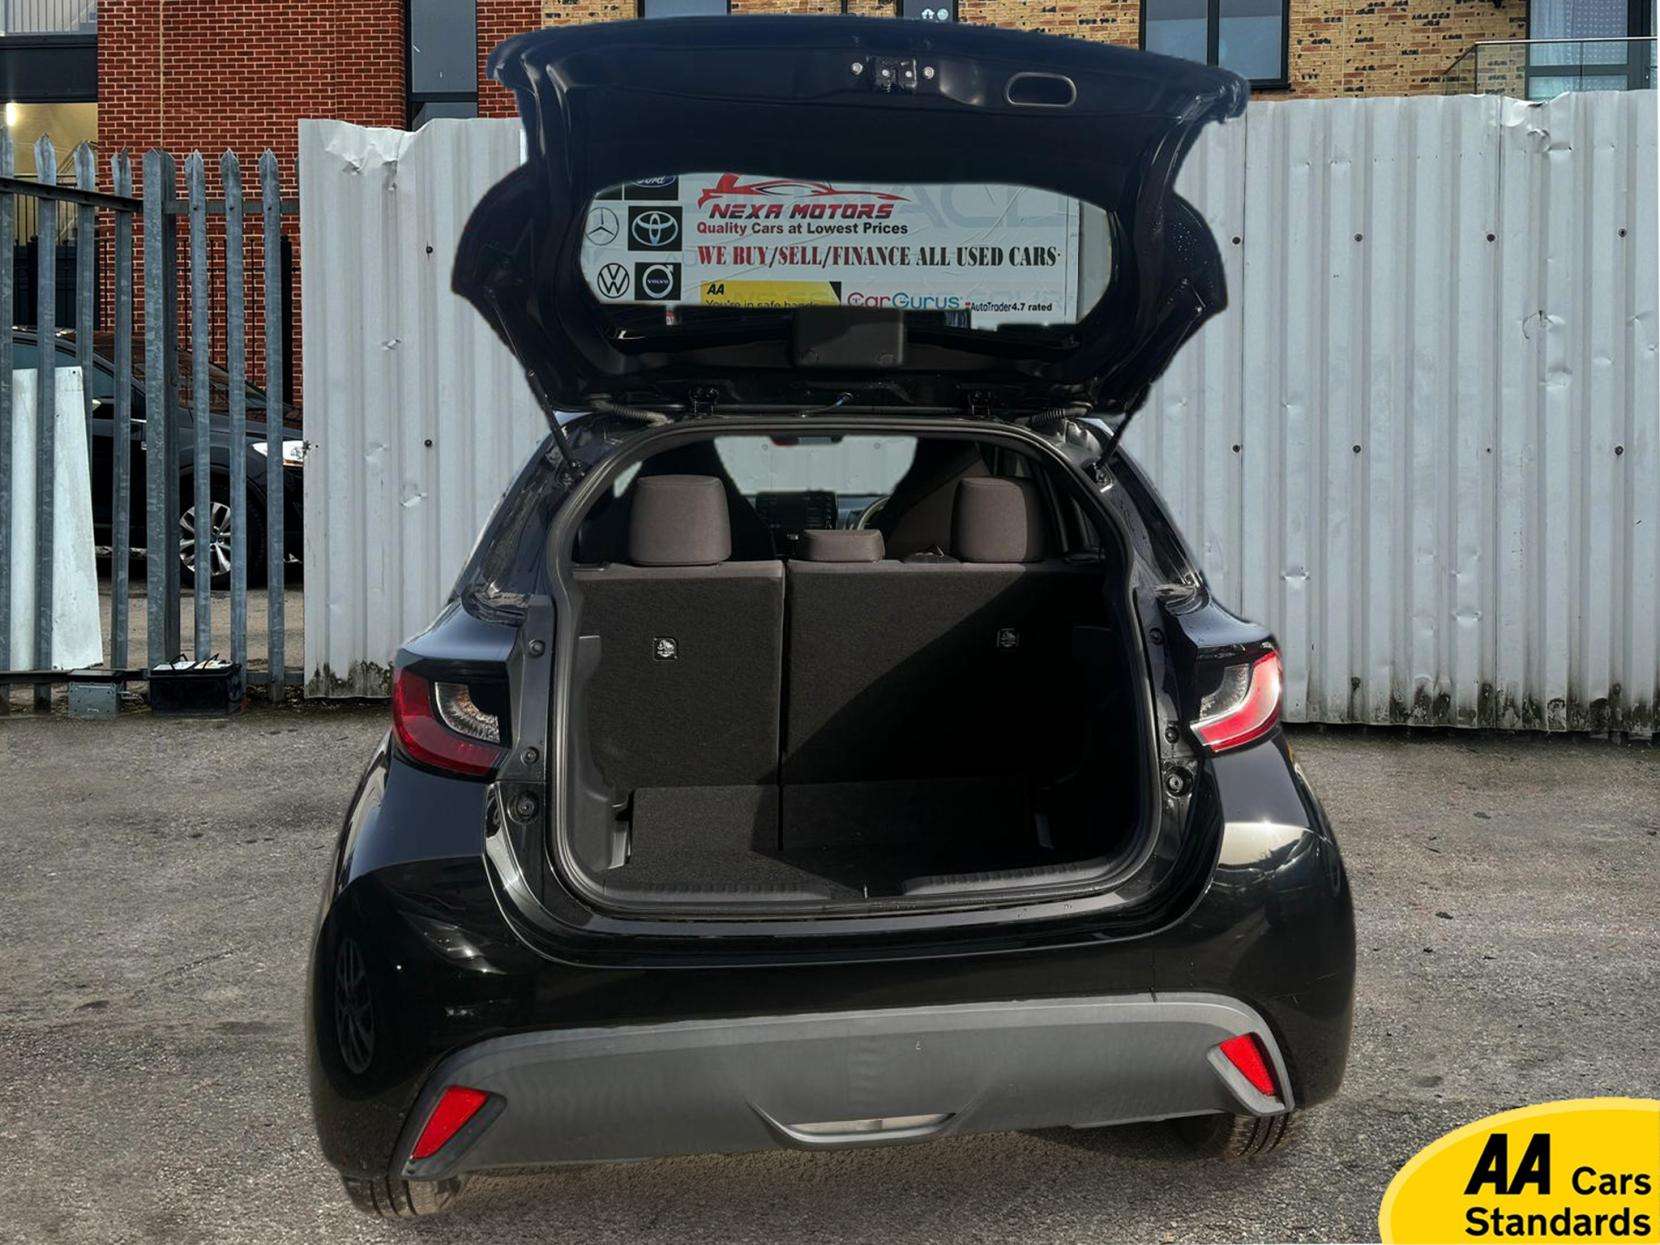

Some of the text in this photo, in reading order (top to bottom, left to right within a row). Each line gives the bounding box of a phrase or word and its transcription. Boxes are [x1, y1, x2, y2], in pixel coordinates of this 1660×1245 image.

[709, 203, 894, 219] NEXA MOTORS
[697, 221, 908, 236] Quality Cars at Lowest Prices
[697, 246, 727, 265] WE
[916, 246, 951, 266] ALL
[956, 246, 1003, 266] USED
[706, 283, 725, 295] AA
[1028, 303, 1052, 312] rated
